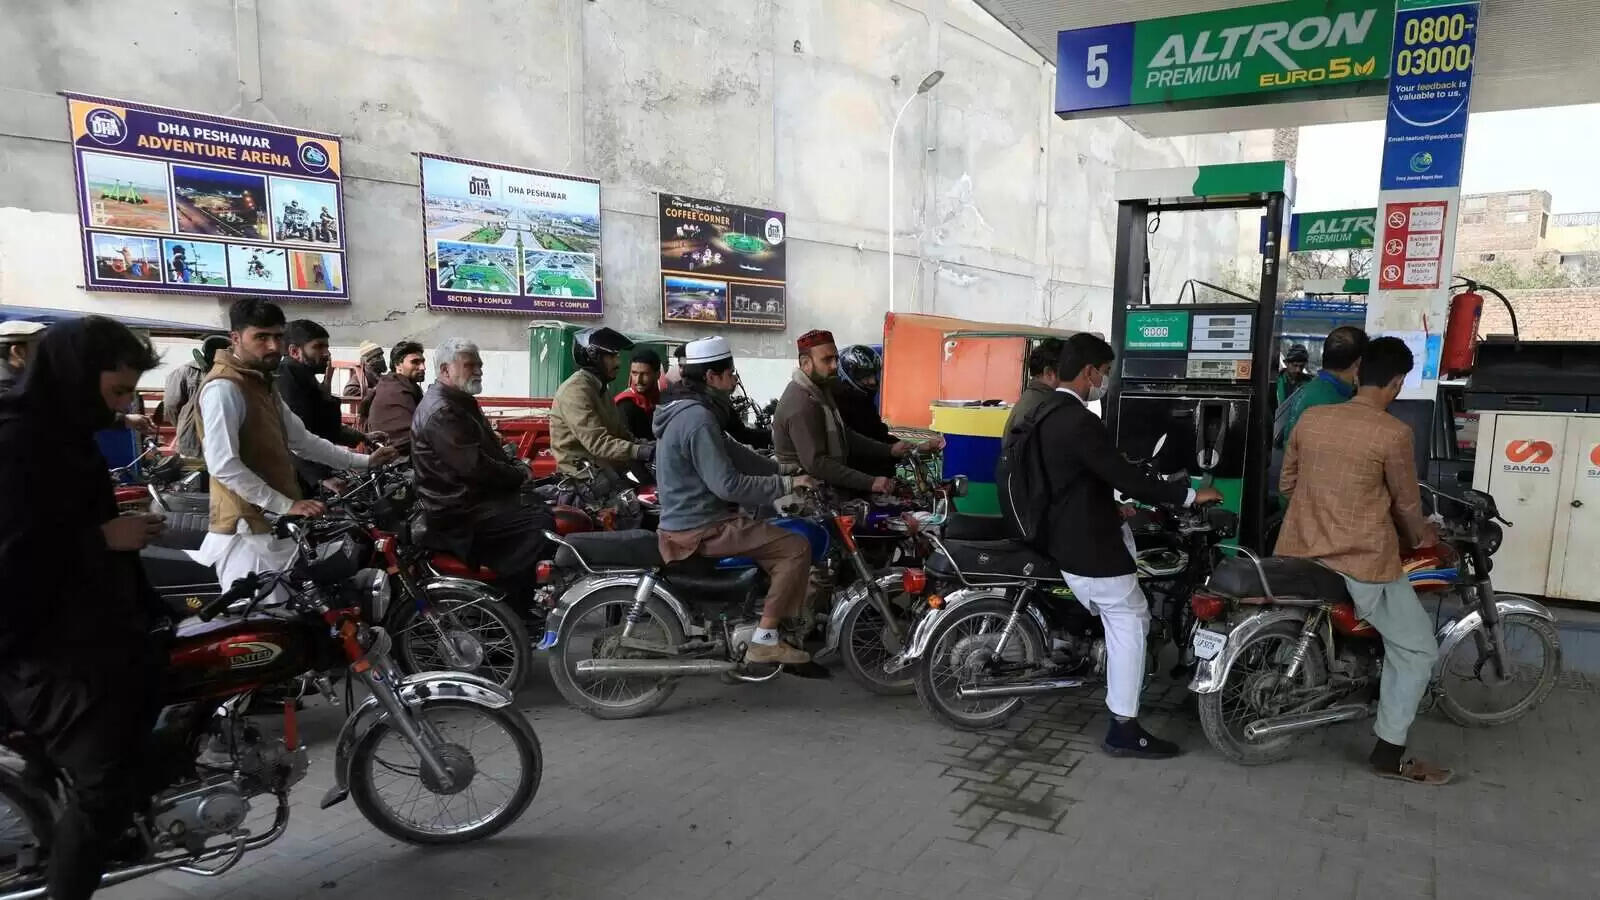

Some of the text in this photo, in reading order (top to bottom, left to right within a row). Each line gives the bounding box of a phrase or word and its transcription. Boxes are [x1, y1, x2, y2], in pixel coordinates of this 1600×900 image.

[1146, 9, 1377, 70] ALTRON
[1404, 13, 1474, 46] 0800-
[1086, 44, 1109, 89] 5
[1396, 43, 1471, 77] 03000
[1145, 62, 1241, 88] PREMIUM
[1259, 57, 1352, 88] EURO 5
[1395, 79, 1467, 93] Your feedback is
[1398, 90, 1435, 101] valuable
[157, 121, 271, 149] DHA PESHAWAR
[137, 134, 292, 168] ADVENTURE ARENA
[508, 185, 567, 200] DHA PESHAWAR
[665, 208, 730, 226] COFFEE CORNER
[1306, 215, 1376, 238] ALTR
[1306, 233, 1352, 244] PREMIUM
[447, 295, 473, 303] SECTOR
[483, 297, 513, 305] COMPLEX
[533, 300, 556, 308] SECTOR
[1503, 464, 1550, 472] SAMOA
[231, 650, 274, 664] UNITED
